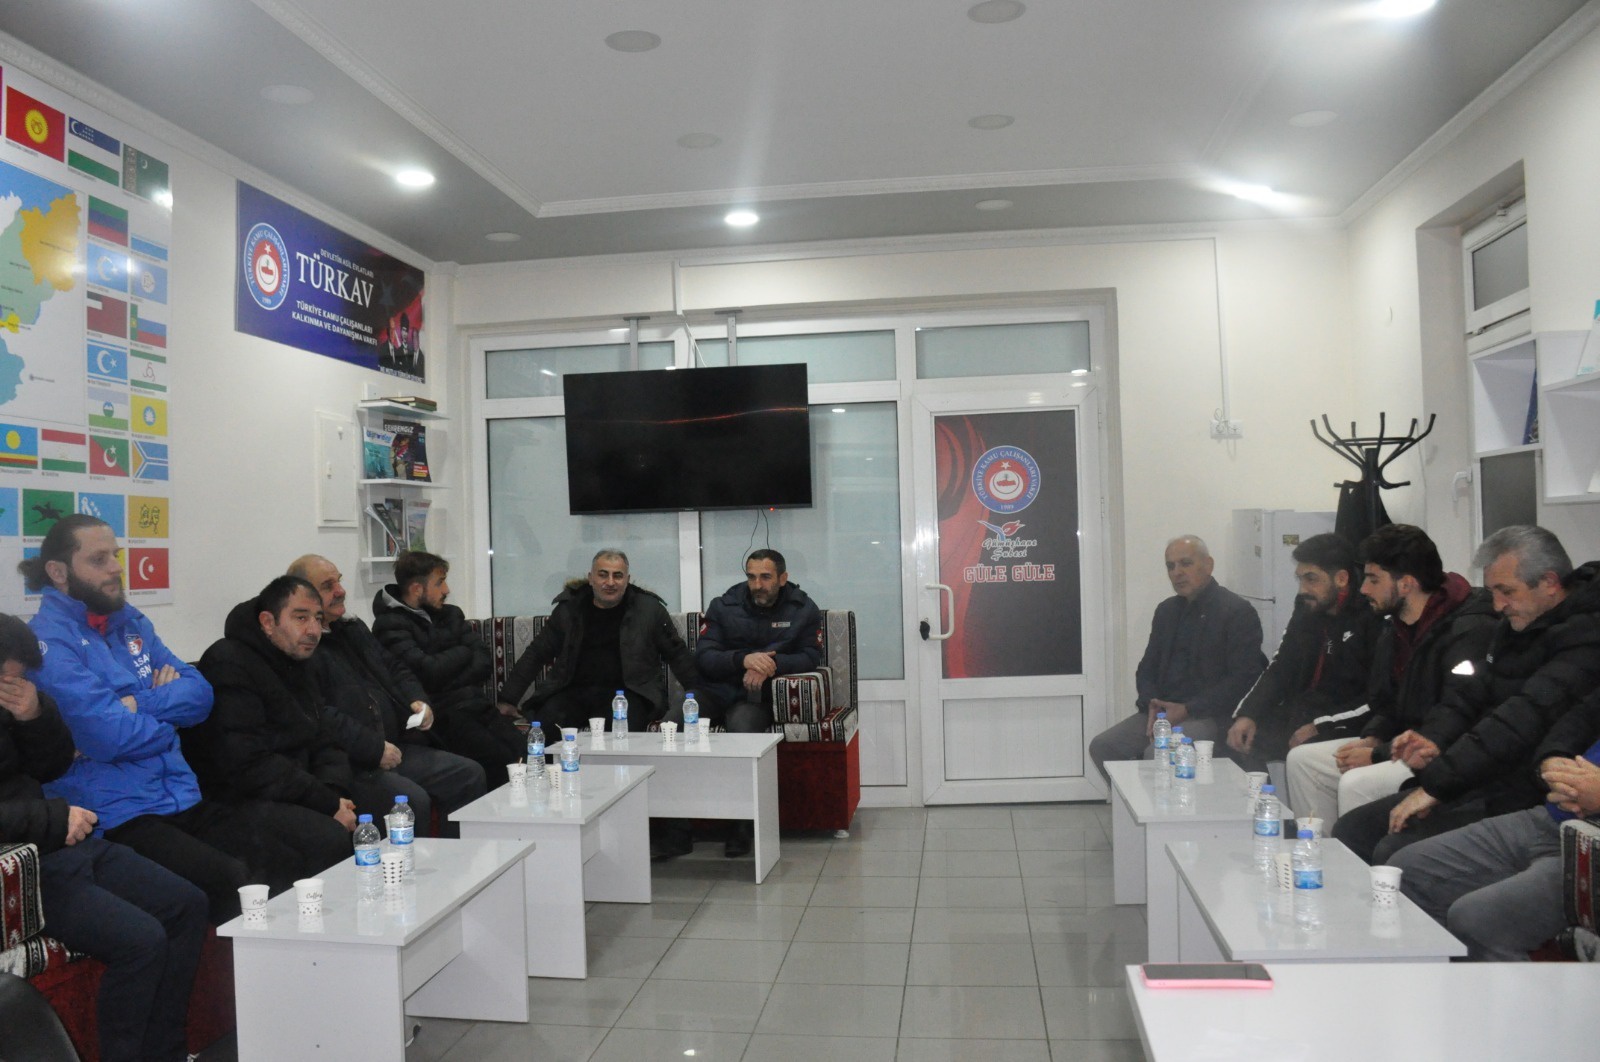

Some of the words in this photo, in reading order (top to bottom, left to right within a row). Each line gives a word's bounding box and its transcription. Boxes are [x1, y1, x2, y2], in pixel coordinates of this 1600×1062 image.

[296, 251, 374, 308] TÜRKAV
[292, 311, 323, 329] KALKINMA
[323, 321, 332, 331] VE
[332, 324, 363, 341] DAYANIŞMA
[363, 334, 378, 346] VAKFI
[296, 300, 322, 317] TÜRKİYE
[322, 308, 340, 323] KAMU
[340, 315, 373, 334] ÇALIŞANLARI
[980, 452, 999, 469] KAMU
[999, 450, 1037, 478] ÇALIŞANLARI
[981, 537, 1038, 548] Gümüşhane
[990, 547, 1028, 562] Şubesi
[963, 563, 1007, 583] GÜLE
[1012, 562, 1056, 582] GÜLE
